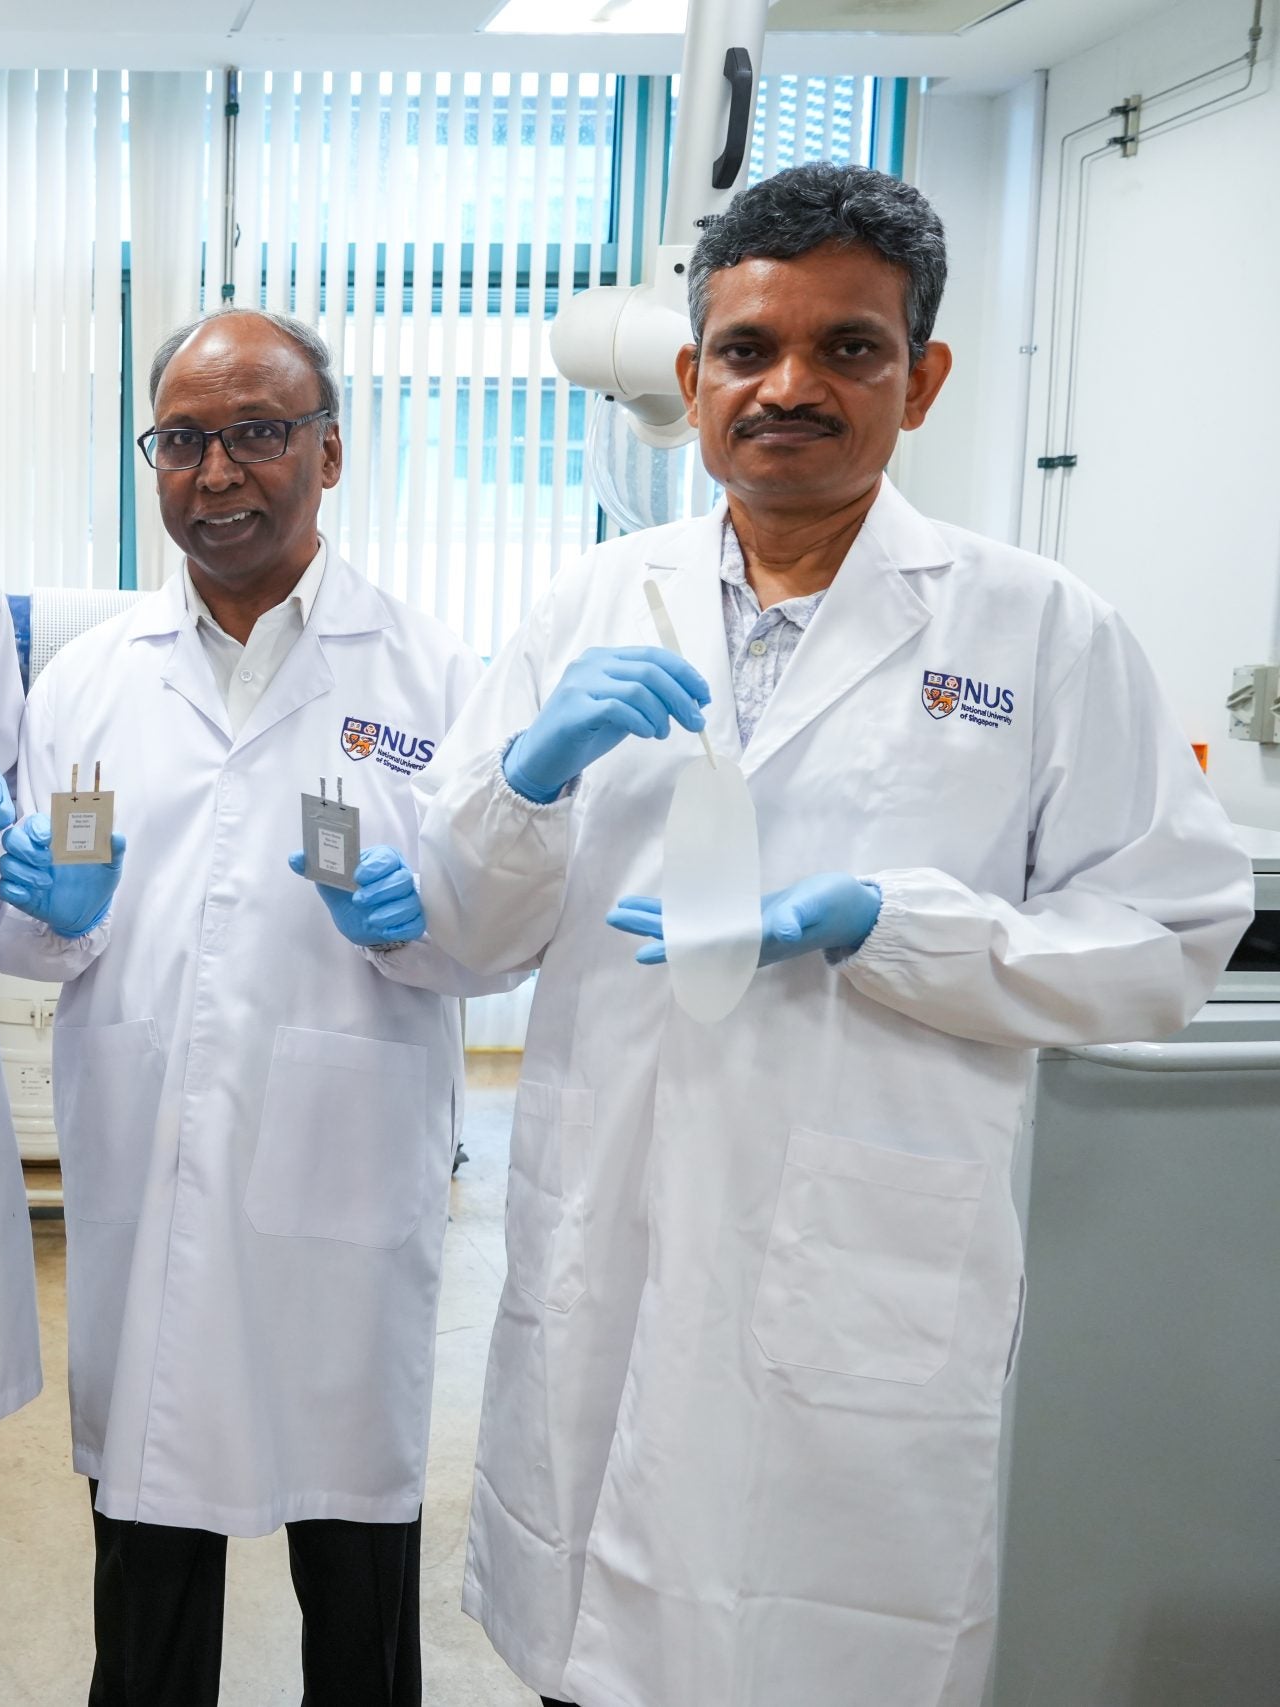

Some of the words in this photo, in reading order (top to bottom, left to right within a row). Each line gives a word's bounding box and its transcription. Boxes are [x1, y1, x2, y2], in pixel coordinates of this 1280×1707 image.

[963, 678, 1014, 714] NUS
[961, 703, 986, 718] National
[986, 711, 1012, 726] University
[968, 714, 998, 728] Singapore
[380, 725, 435, 763] NUS
[377, 748, 401, 764] National
[383, 759, 411, 776] Singapore
